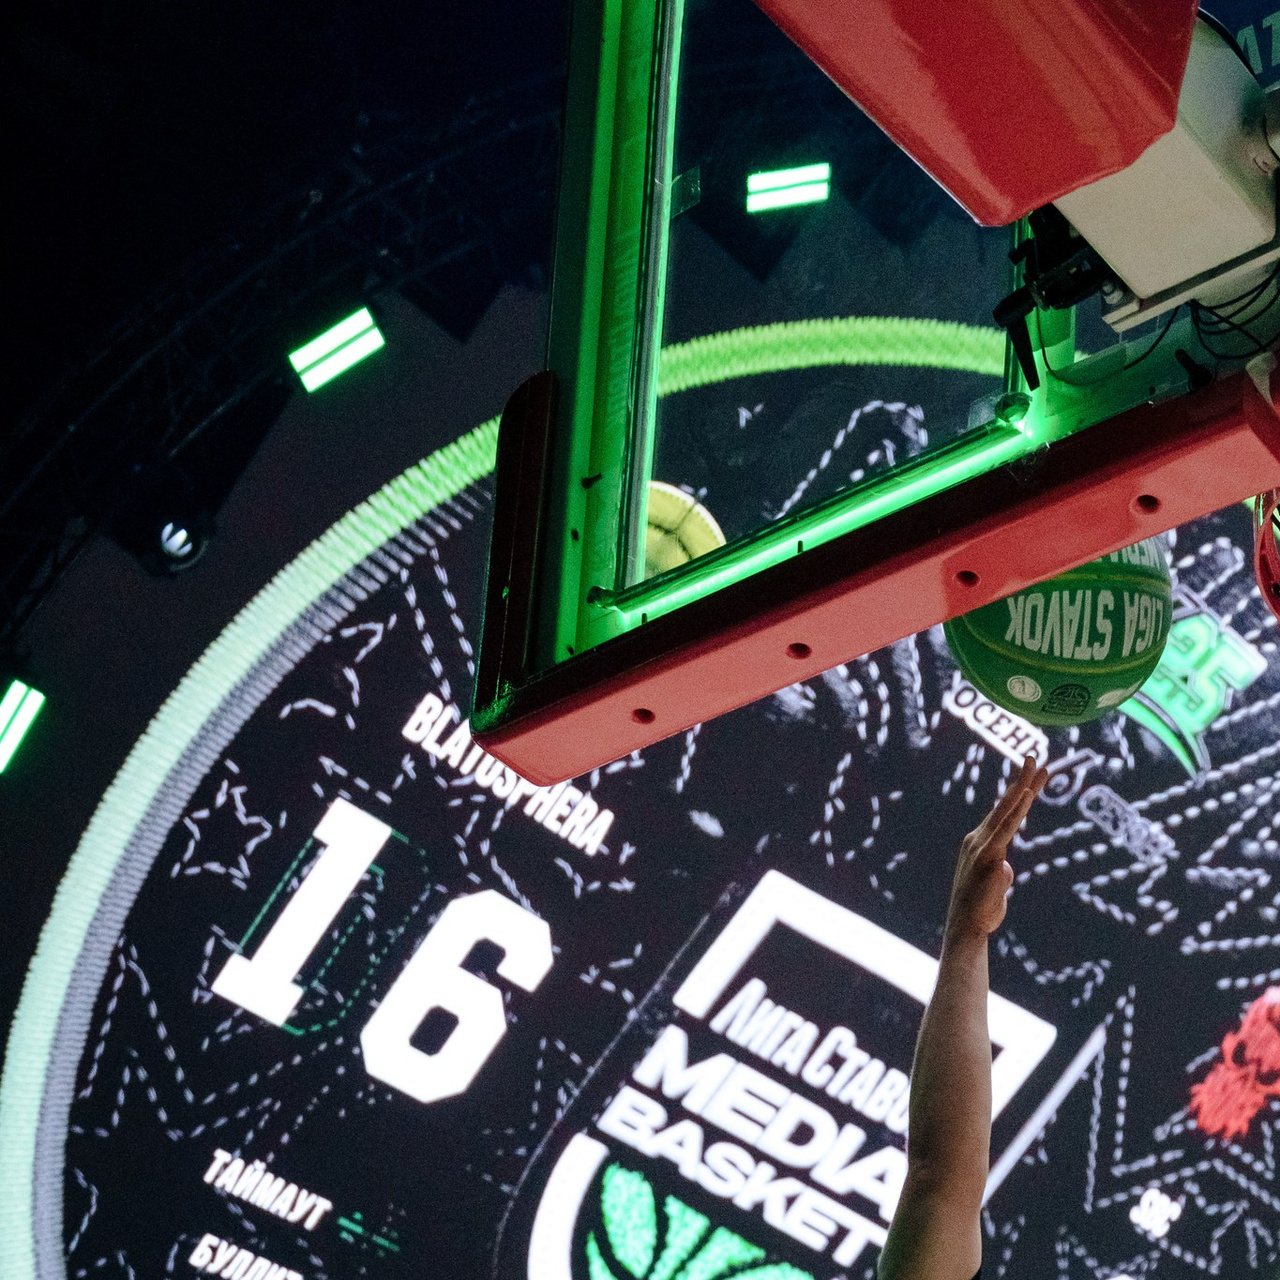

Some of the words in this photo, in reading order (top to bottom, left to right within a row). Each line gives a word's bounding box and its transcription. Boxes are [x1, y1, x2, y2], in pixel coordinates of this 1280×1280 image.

[1004, 588, 1115, 662] STAVOK
[1122, 590, 1165, 658] LIGA
[952, 683, 1045, 763] ОСЕНЬ
[633, 1023, 910, 1217] MEDIA
[202, 1148, 333, 1231] ТАЙМАУТ
[596, 1085, 890, 1267] BASKET
